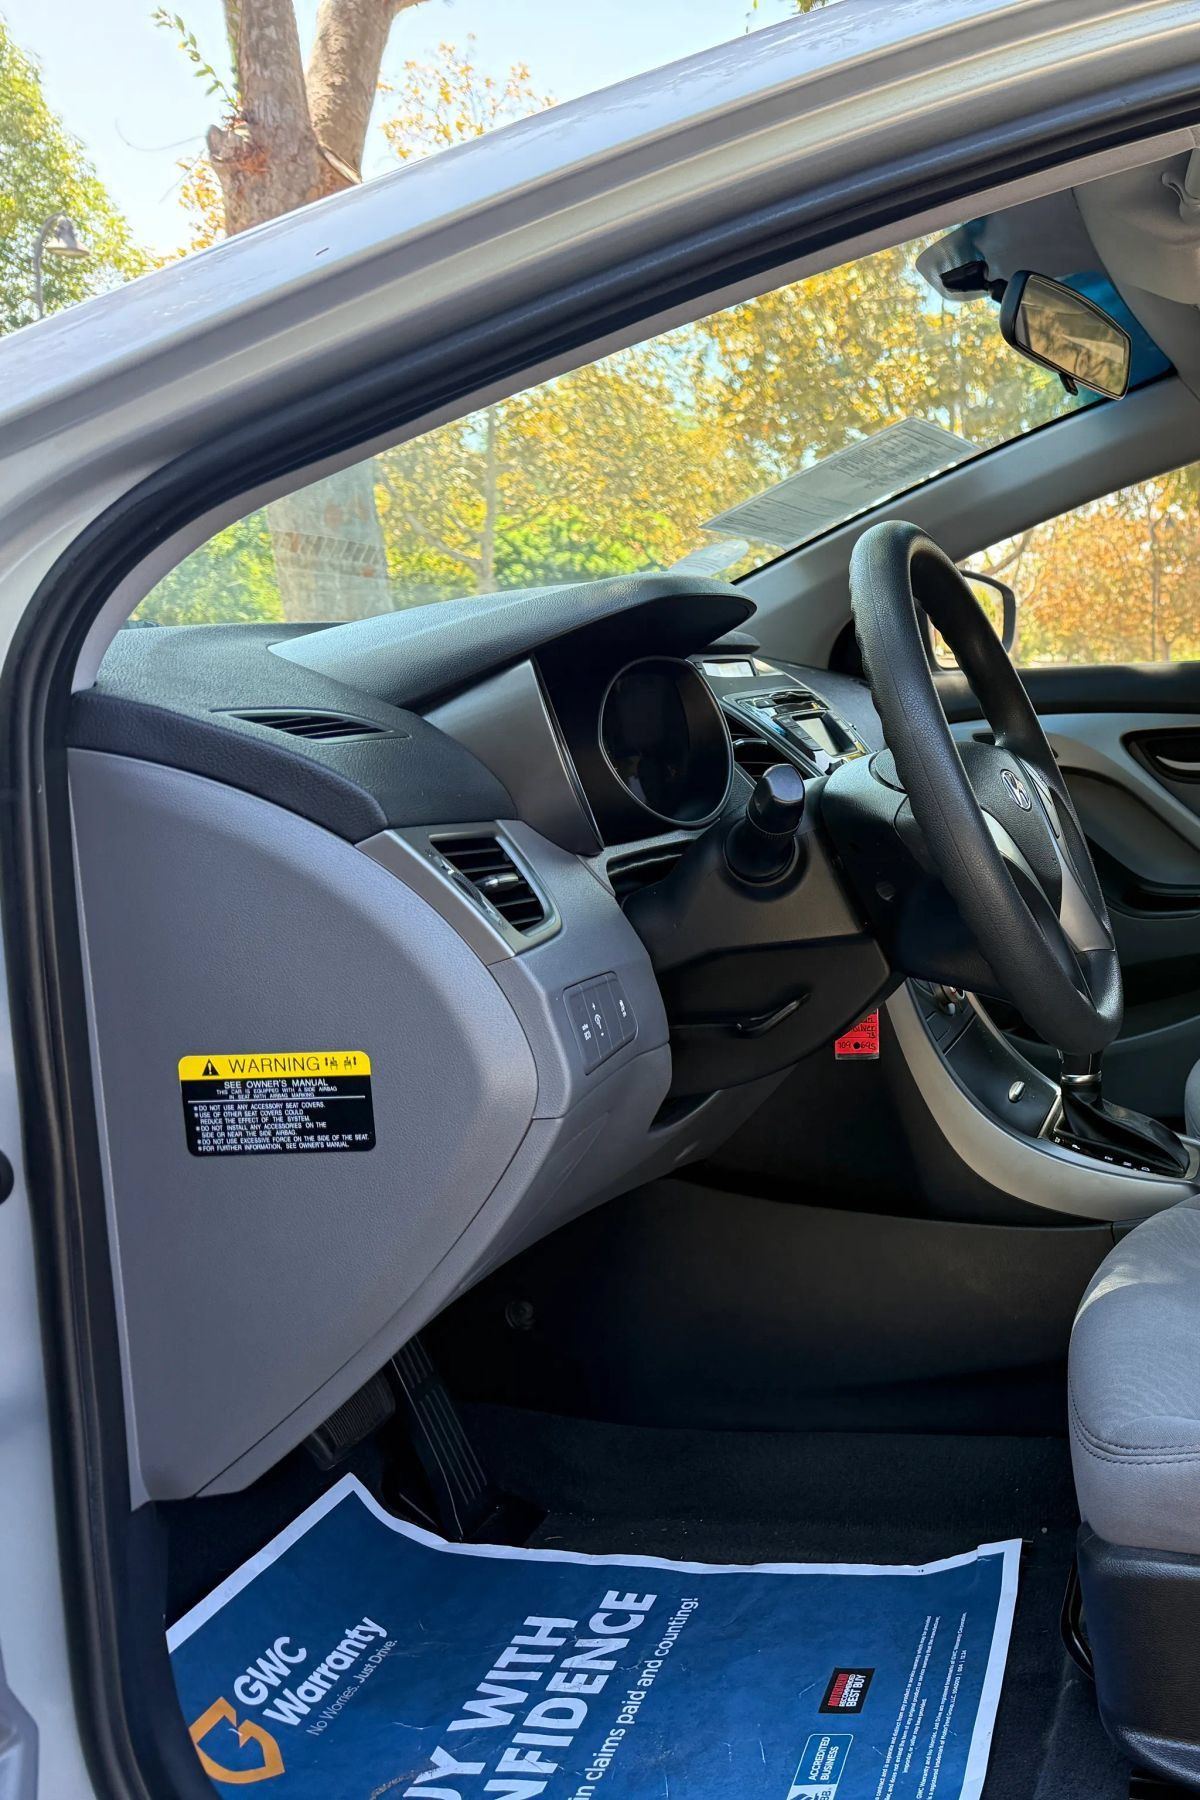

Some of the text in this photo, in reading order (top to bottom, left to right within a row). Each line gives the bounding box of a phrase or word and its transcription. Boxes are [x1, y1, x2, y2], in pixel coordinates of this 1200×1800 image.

[224, 1078, 328, 1089] SEE OWNER'S MANUAL
[228, 1056, 320, 1073] WARNING
[264, 1122, 302, 1130] ACCESSORIES
[234, 1636, 307, 1706] GWC
[262, 1616, 388, 1726] Warranty
[306, 1639, 398, 1736] No Worries. Just Drive.
[446, 1615, 578, 1731] WITH
[584, 1727, 626, 1781] claims
[616, 1690, 647, 1724] paid
[637, 1660, 664, 1687] and
[654, 1597, 699, 1657] counting!
[846, 1674, 866, 1707] BEST BUY
[808, 1737, 830, 1781] ACCREDITED
[820, 1746, 839, 1780] BUSINESS
